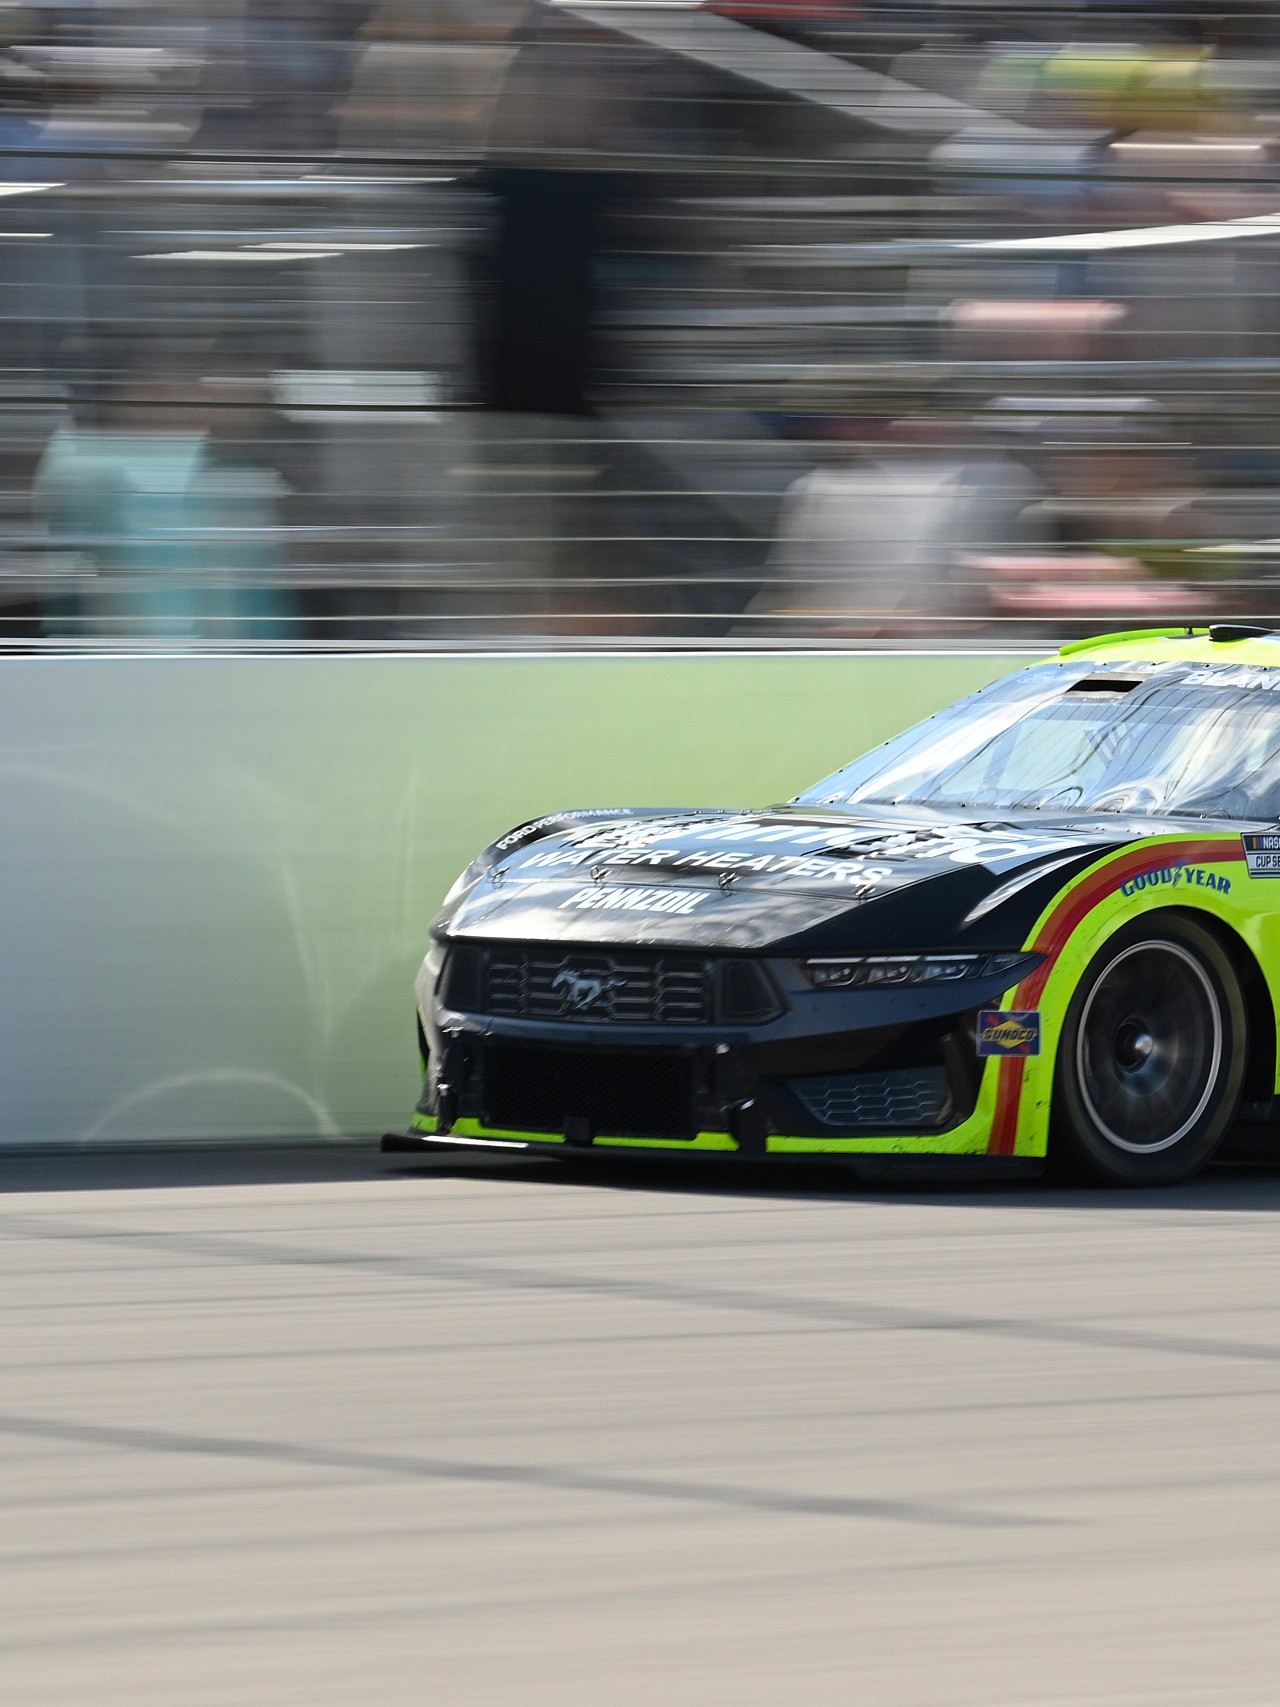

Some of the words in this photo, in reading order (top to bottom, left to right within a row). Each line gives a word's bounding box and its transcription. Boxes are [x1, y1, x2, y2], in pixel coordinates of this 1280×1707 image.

[495, 822, 538, 850] FORD
[534, 809, 634, 829] PERFORMANCE
[518, 849, 682, 869] WATER
[672, 850, 894, 885] HEATERS
[1255, 855, 1272, 868] CUP
[1120, 861, 1232, 897] GOODYEAR
[558, 887, 712, 914] PENNZOIL
[982, 1027, 1037, 1041] SUNOCO
